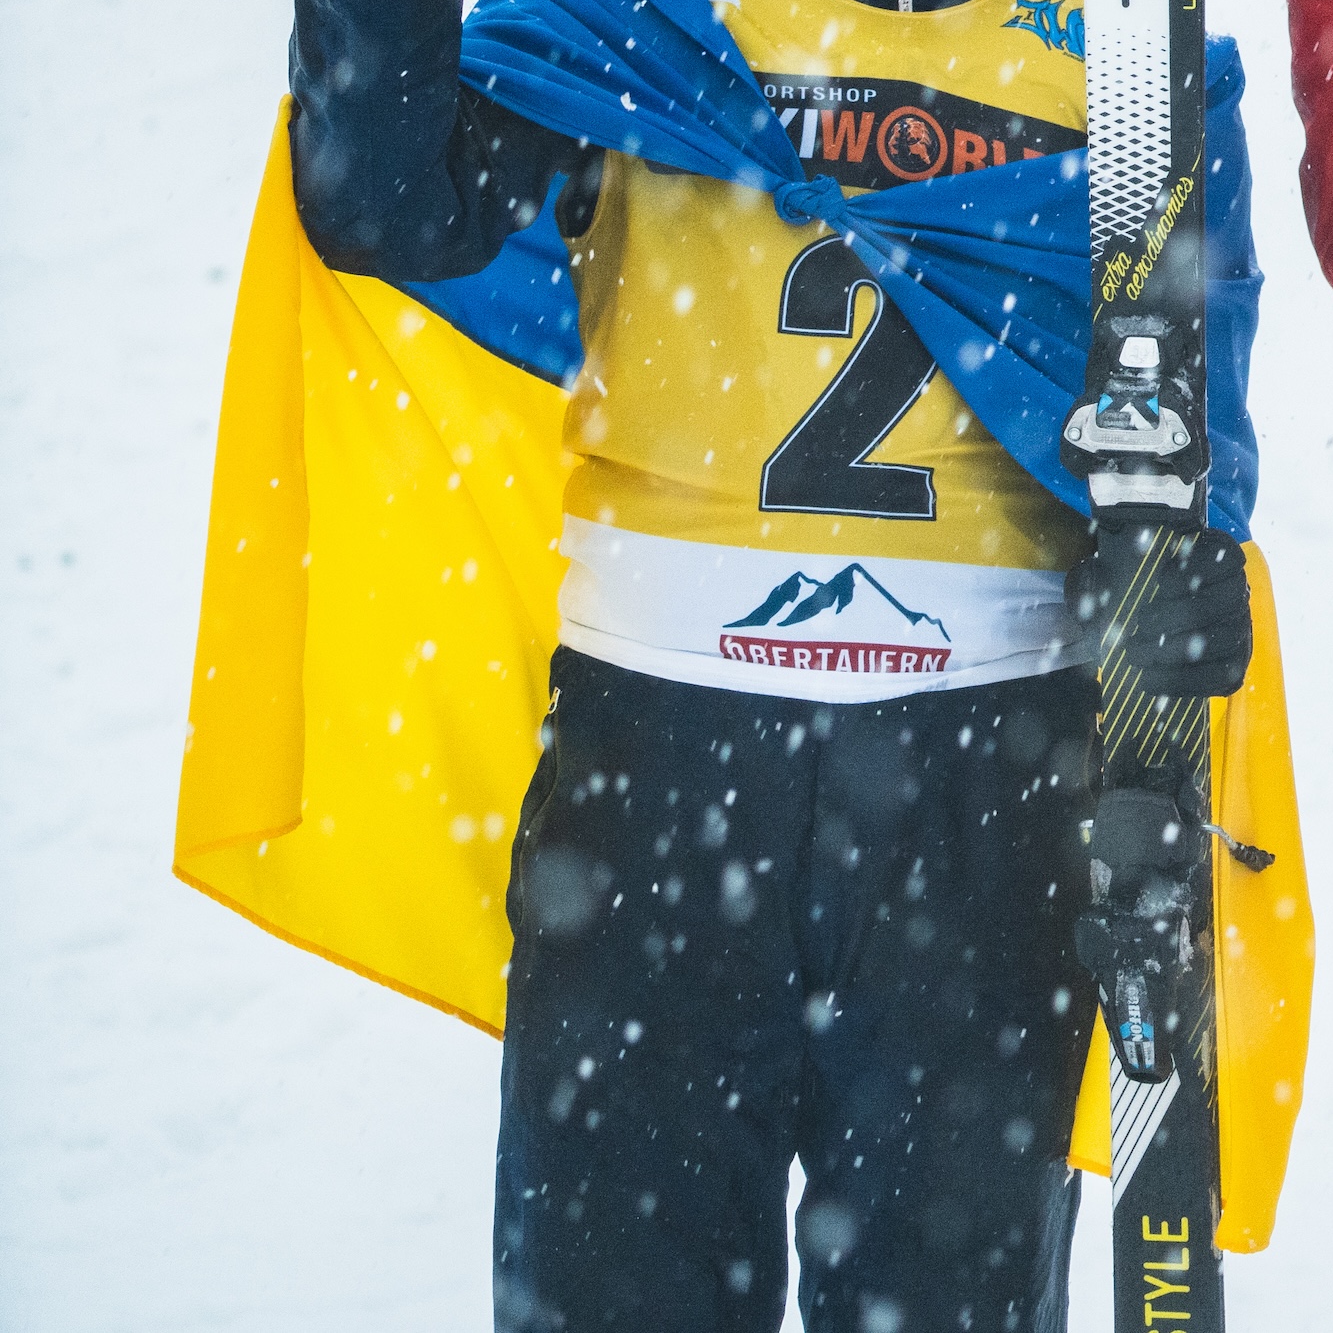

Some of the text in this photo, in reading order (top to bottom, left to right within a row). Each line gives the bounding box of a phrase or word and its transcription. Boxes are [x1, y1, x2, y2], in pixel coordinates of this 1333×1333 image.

[1101, 250, 1132, 302] extra
[1126, 176, 1194, 301] aerodinamics
[759, 233, 938, 522] 2
[1142, 1215, 1191, 1333] TYLE
